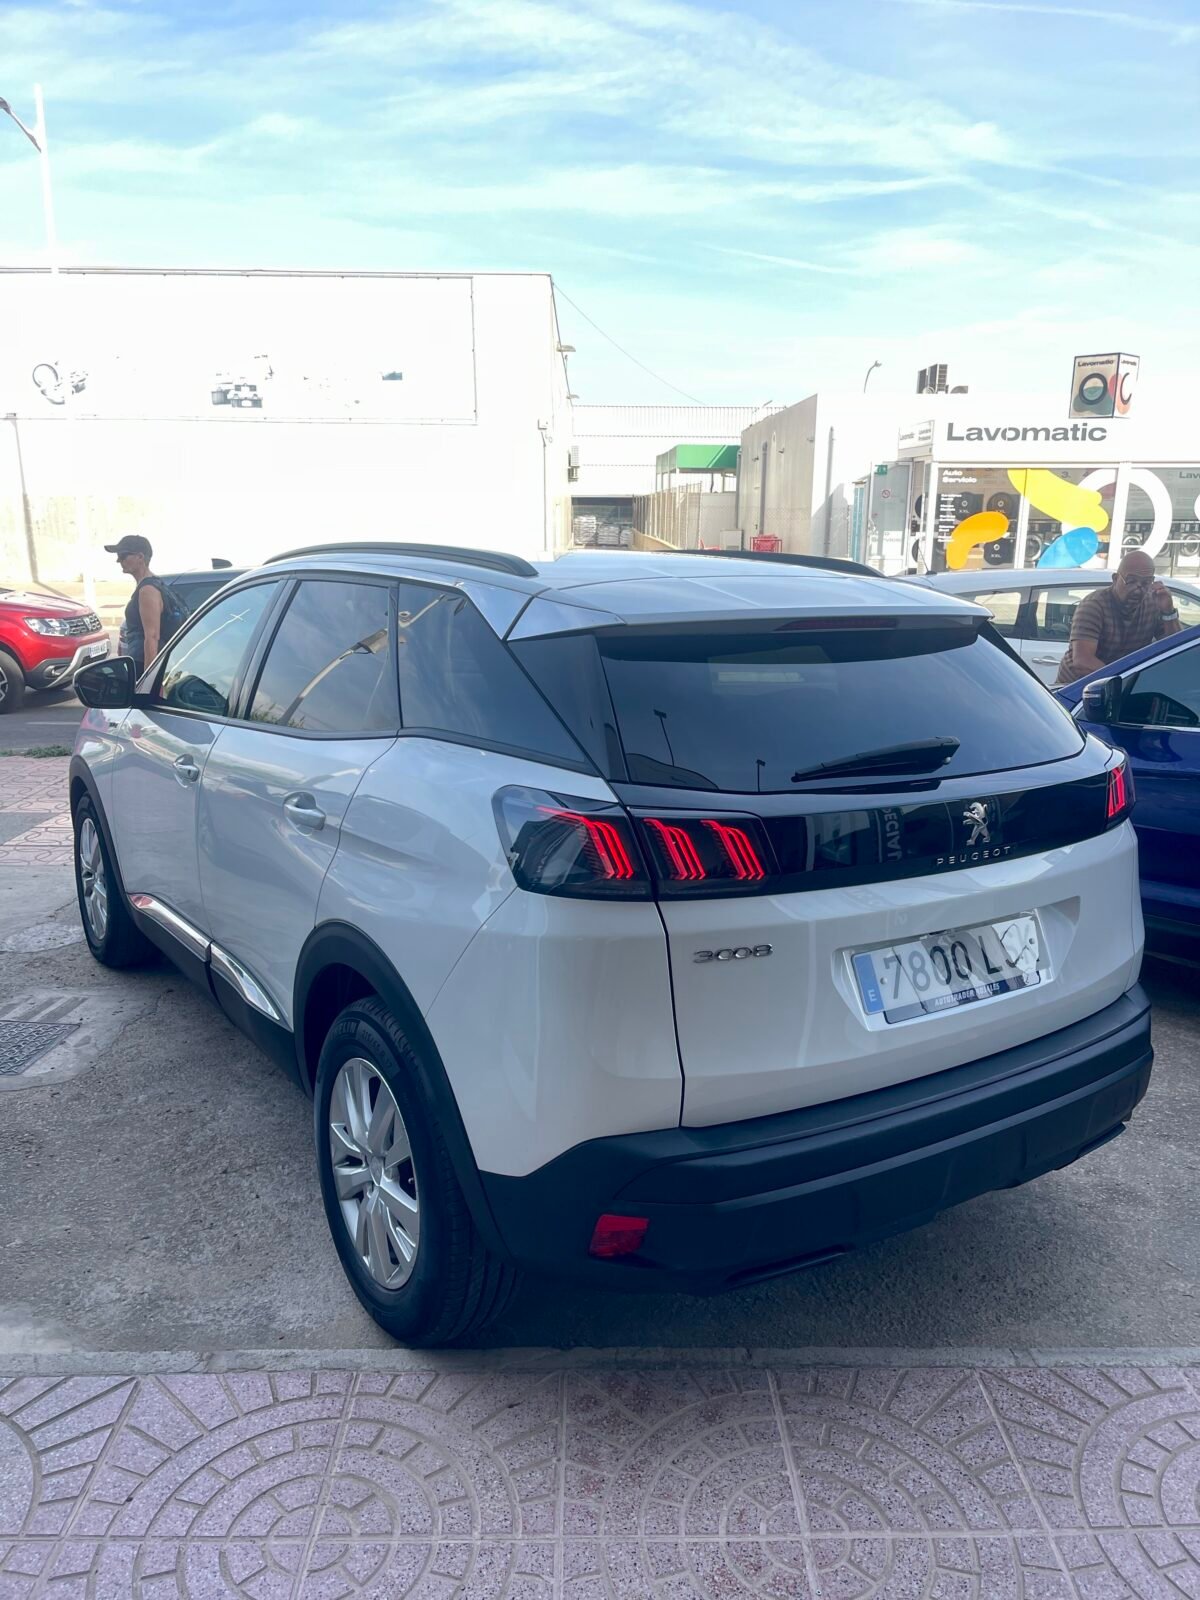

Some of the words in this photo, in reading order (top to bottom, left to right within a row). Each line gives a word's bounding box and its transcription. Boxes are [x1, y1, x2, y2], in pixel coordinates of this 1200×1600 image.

[1077, 359, 1114, 367] Lavomatic
[946, 422, 1107, 442] Lavomatic
[942, 476, 977, 484] Servicio
[1179, 471, 1200, 479] Lav
[936, 846, 1011, 867] PEUGEOT
[693, 943, 773, 963] 3008
[868, 990, 876, 1002] E
[883, 940, 973, 999] 7800
